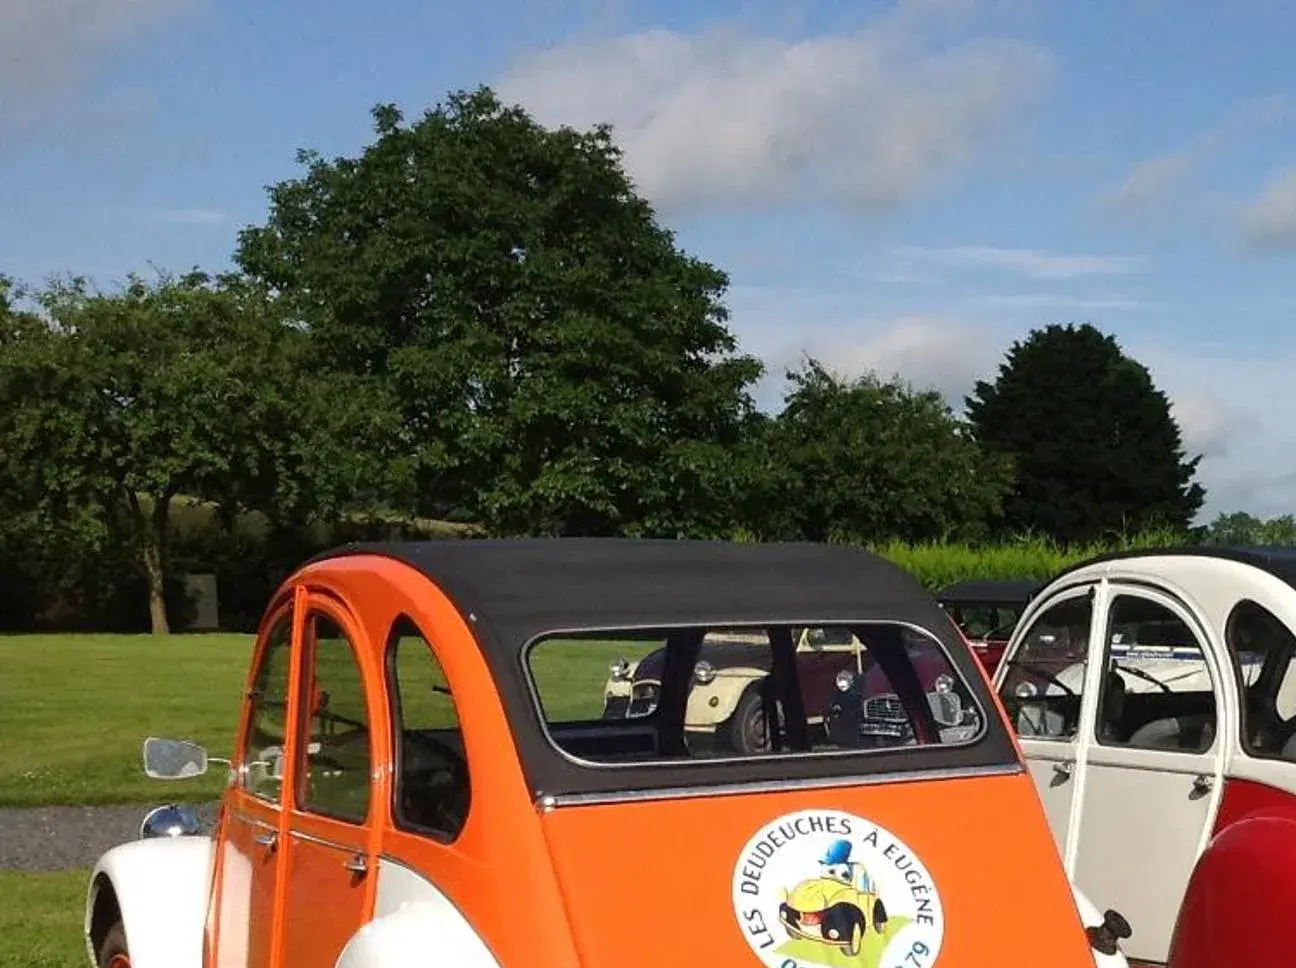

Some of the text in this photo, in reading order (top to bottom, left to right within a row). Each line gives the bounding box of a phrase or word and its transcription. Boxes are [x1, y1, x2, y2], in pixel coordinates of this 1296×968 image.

[741, 816, 852, 896] DEUDEUCHES
[743, 908, 775, 949] LES
[905, 941, 930, 968] 79
